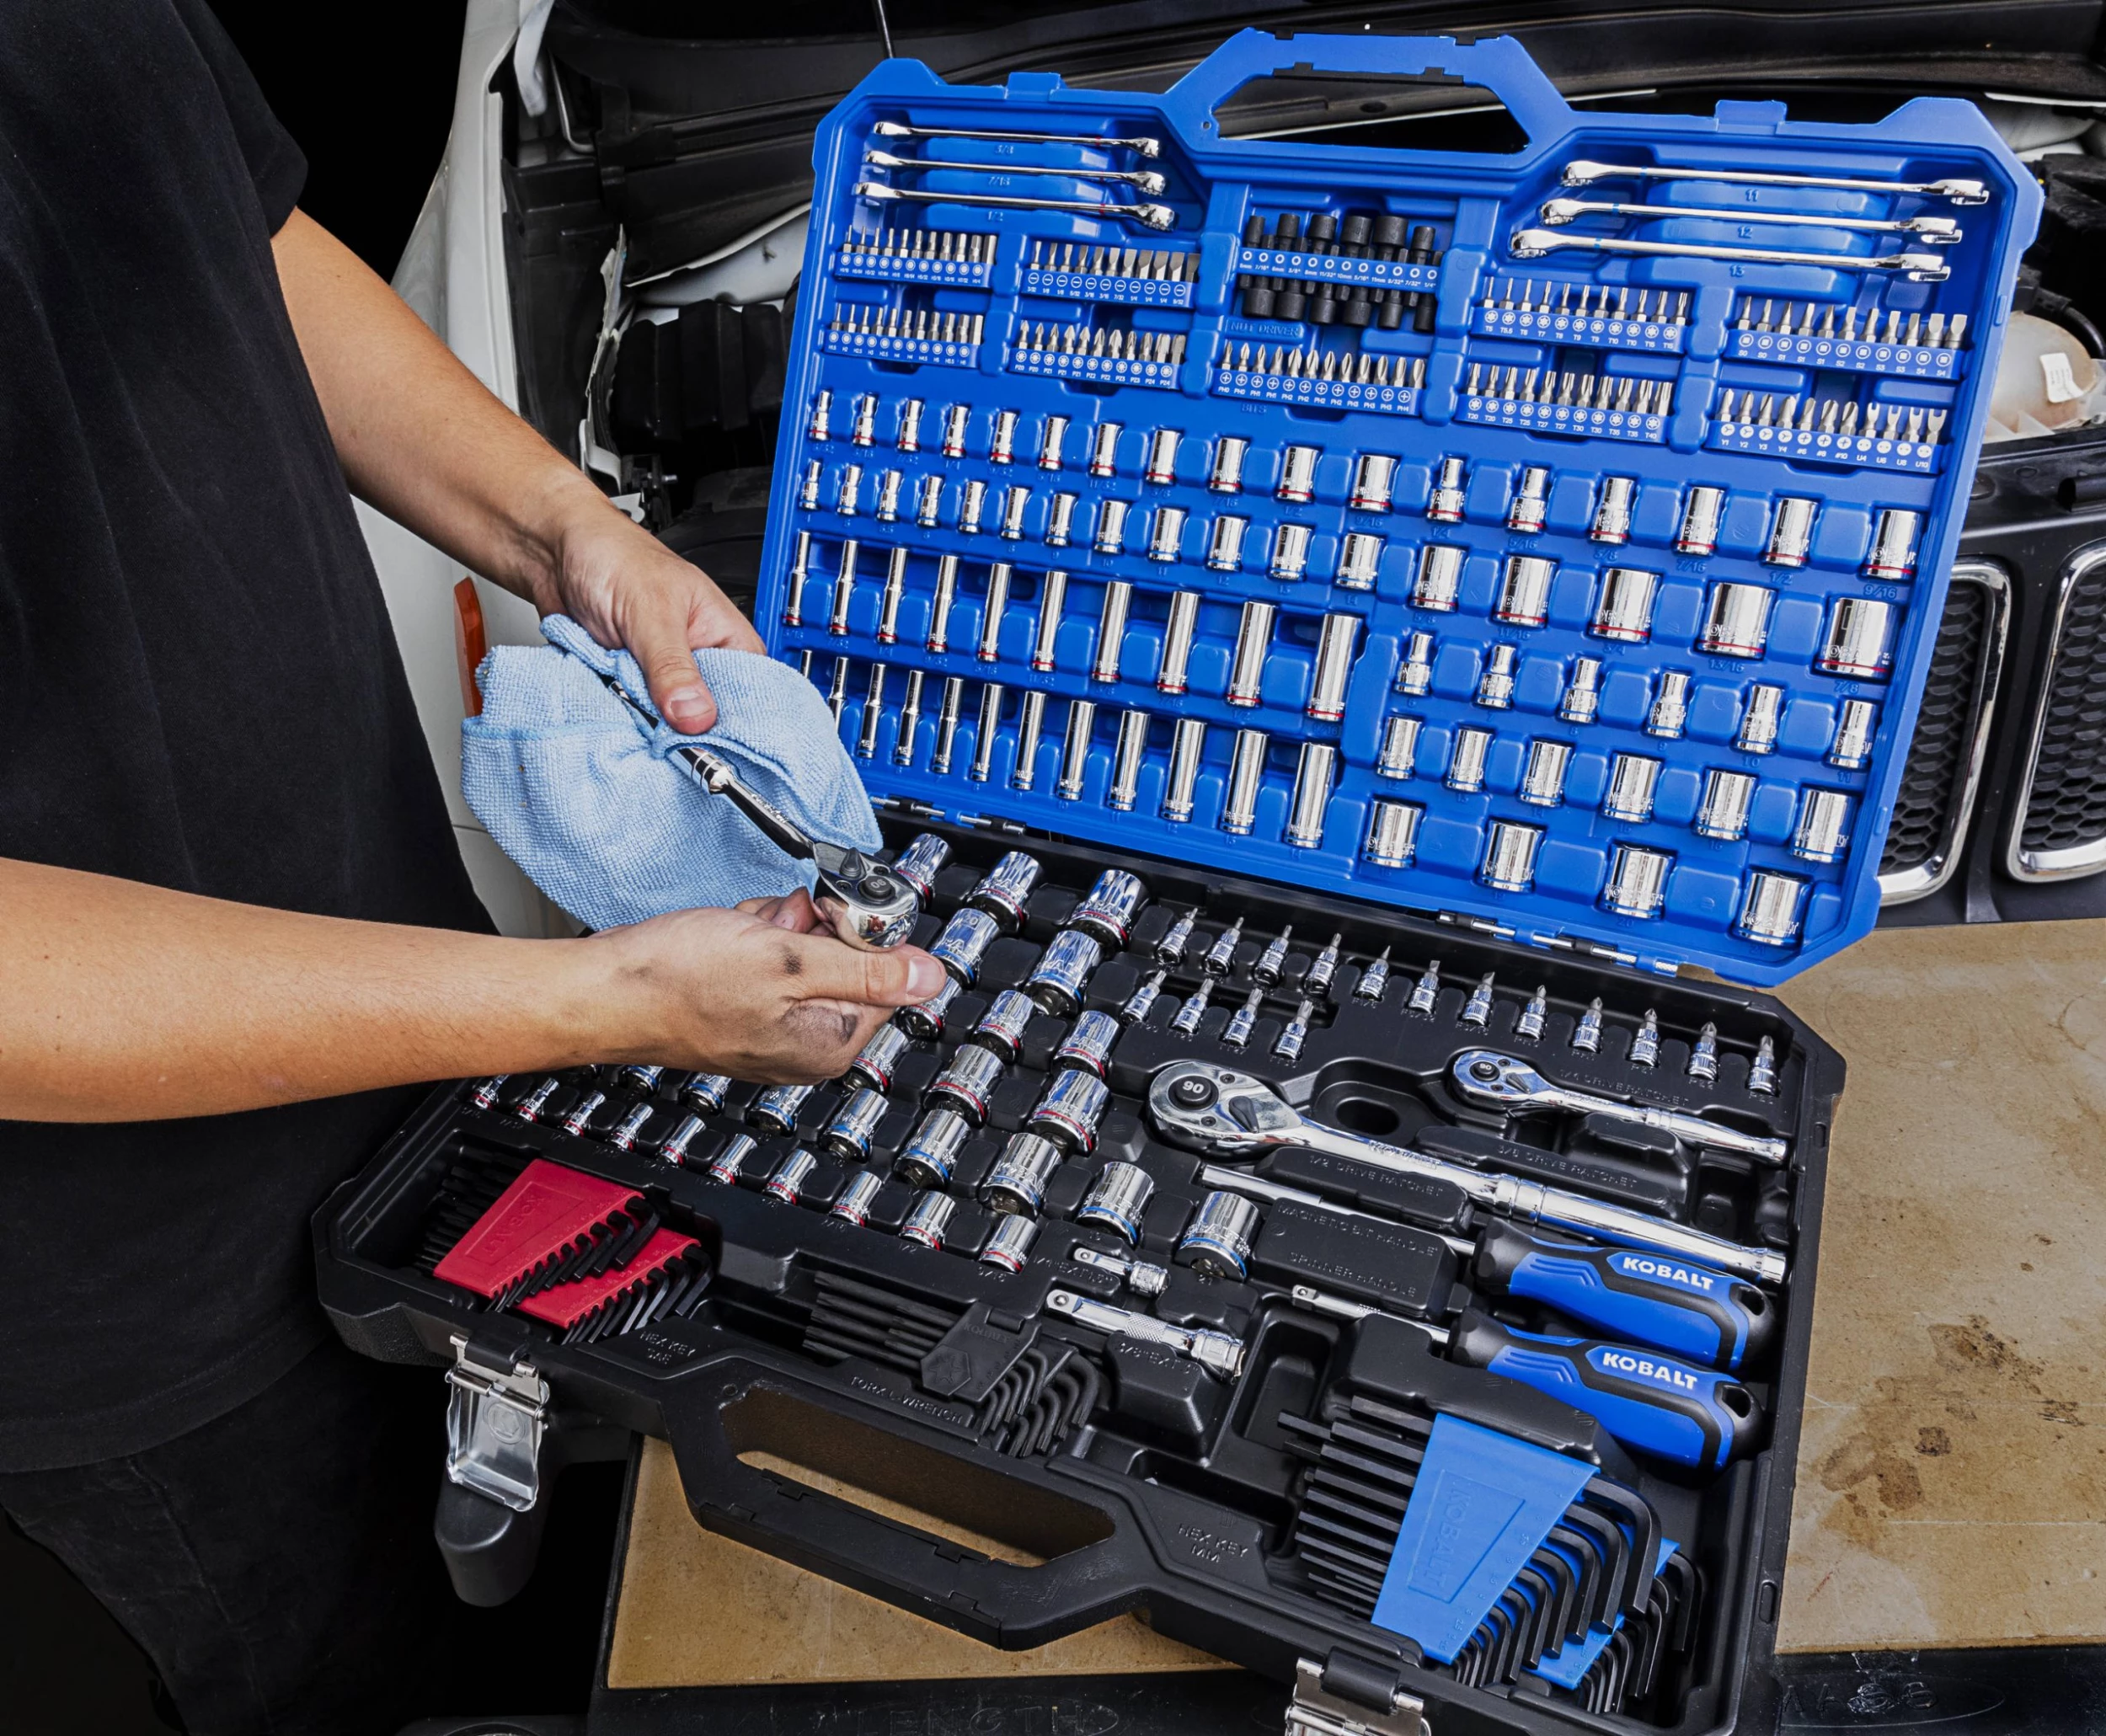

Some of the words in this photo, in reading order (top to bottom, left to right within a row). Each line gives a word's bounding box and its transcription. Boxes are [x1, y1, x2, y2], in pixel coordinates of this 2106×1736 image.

[1745, 189, 1759, 202] 11
[1738, 226, 1753, 239] 12
[1230, 321, 1253, 332] NUT
[1259, 323, 1302, 337] DRIVER
[1769, 571, 1793, 585] 1/2
[1863, 585, 1897, 599] 9/16
[1182, 1081, 1205, 1094] 90
[1584, 1074, 1622, 1092] DRIVE
[1626, 1083, 1690, 1106] RATCHET
[1309, 1155, 1328, 1167] 1/2
[1336, 1162, 1376, 1180] DRIVE
[1380, 1172, 1444, 1197] RATCHET
[1525, 1152, 1567, 1169] DRIVE
[1571, 1165, 1638, 1188] RATCHET
[1277, 1204, 1348, 1231] MAGNETIC
[1353, 1226, 1375, 1238] BIT
[1376, 1231, 1437, 1257] HANDLE
[1289, 1252, 1351, 1278] SPINNER
[1357, 1274, 1417, 1297] HANDLE
[1622, 1257, 1713, 1290] KOBALT
[640, 1331, 666, 1348] HEX
[669, 1341, 696, 1356] KEY
[1602, 1352, 1698, 1390] KOBALT
[851, 1376, 886, 1397] TORX
[890, 1390, 963, 1424] L-WRENCH
[1178, 1525, 1211, 1544] HEX
[1216, 1540, 1248, 1557] KEY
[1427, 1486, 1472, 1589] KOBALT
[1191, 1545, 1221, 1563] MM
